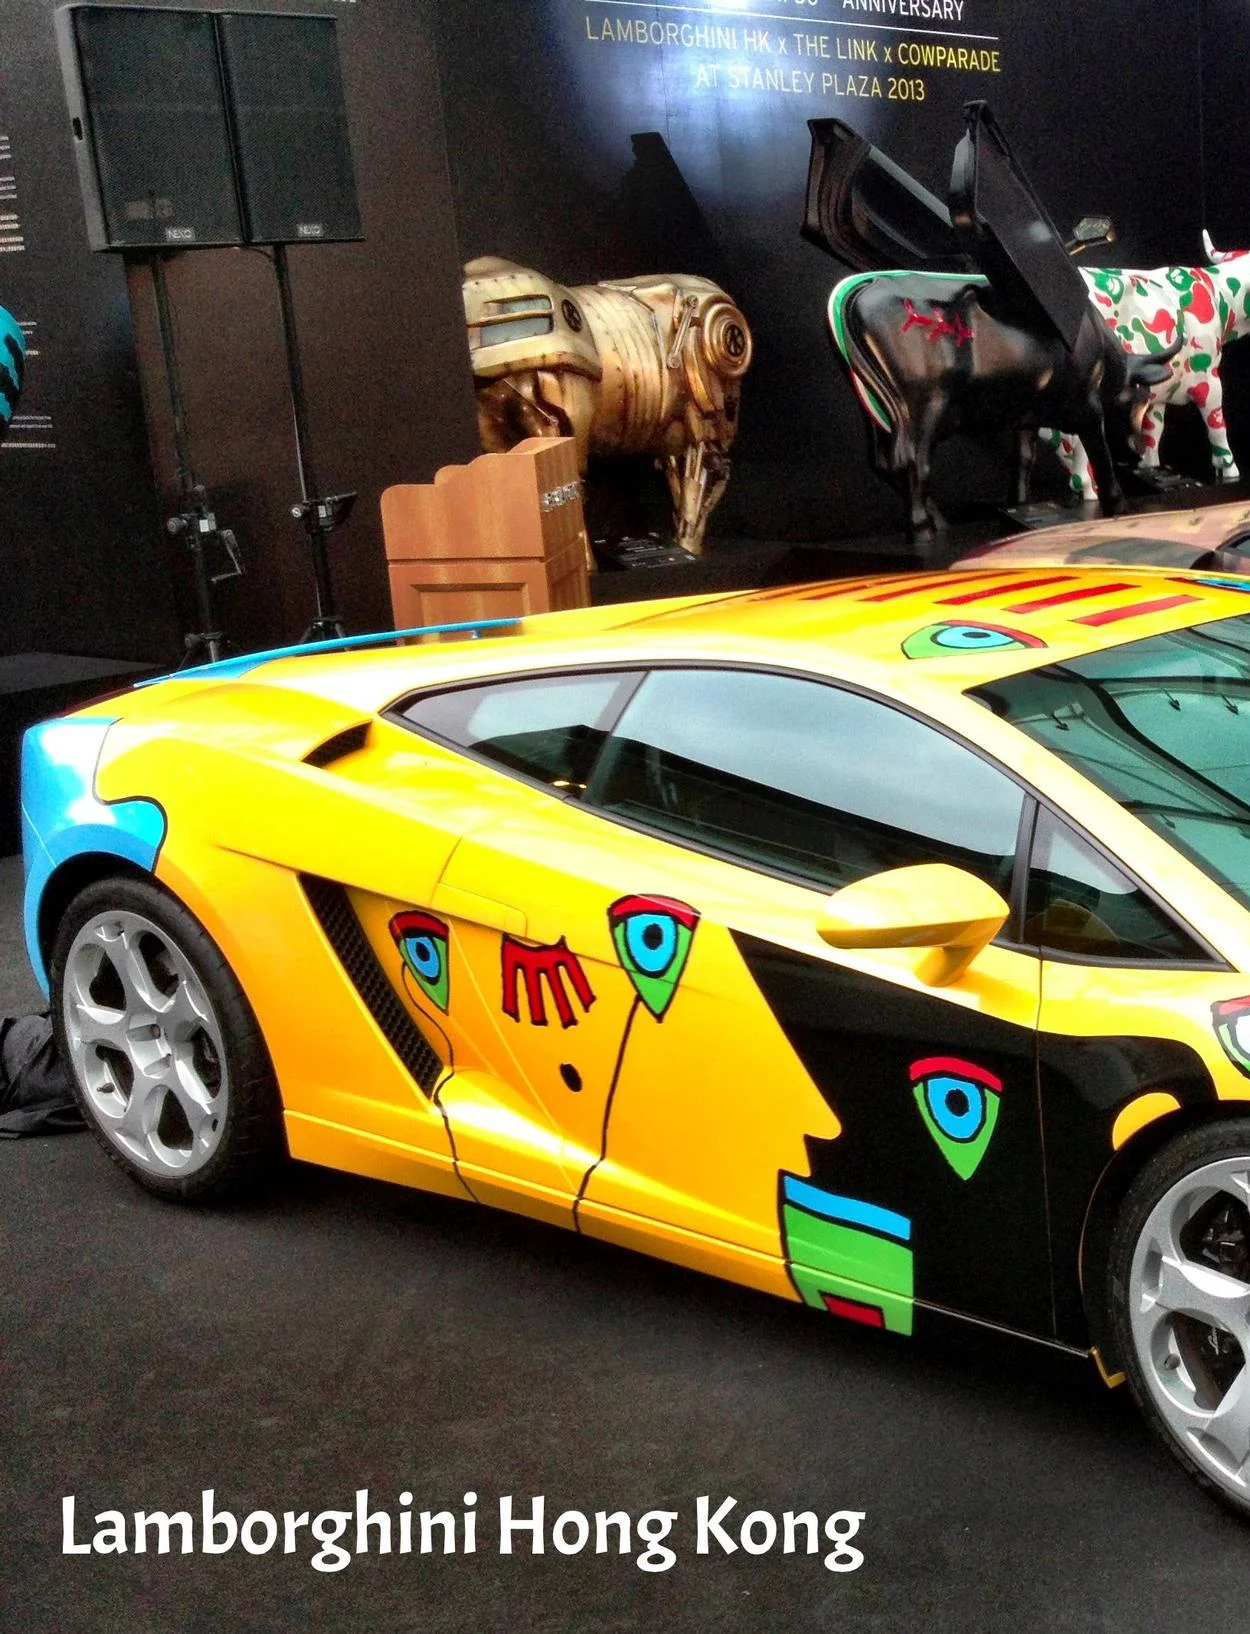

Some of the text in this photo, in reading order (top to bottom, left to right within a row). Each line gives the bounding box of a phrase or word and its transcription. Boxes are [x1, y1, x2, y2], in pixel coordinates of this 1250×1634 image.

[586, 16, 1001, 72] LAMBORGHINI HK x THE LINK x COWPARADE
[695, 63, 925, 101] AT STANLEY PLAZA 2013
